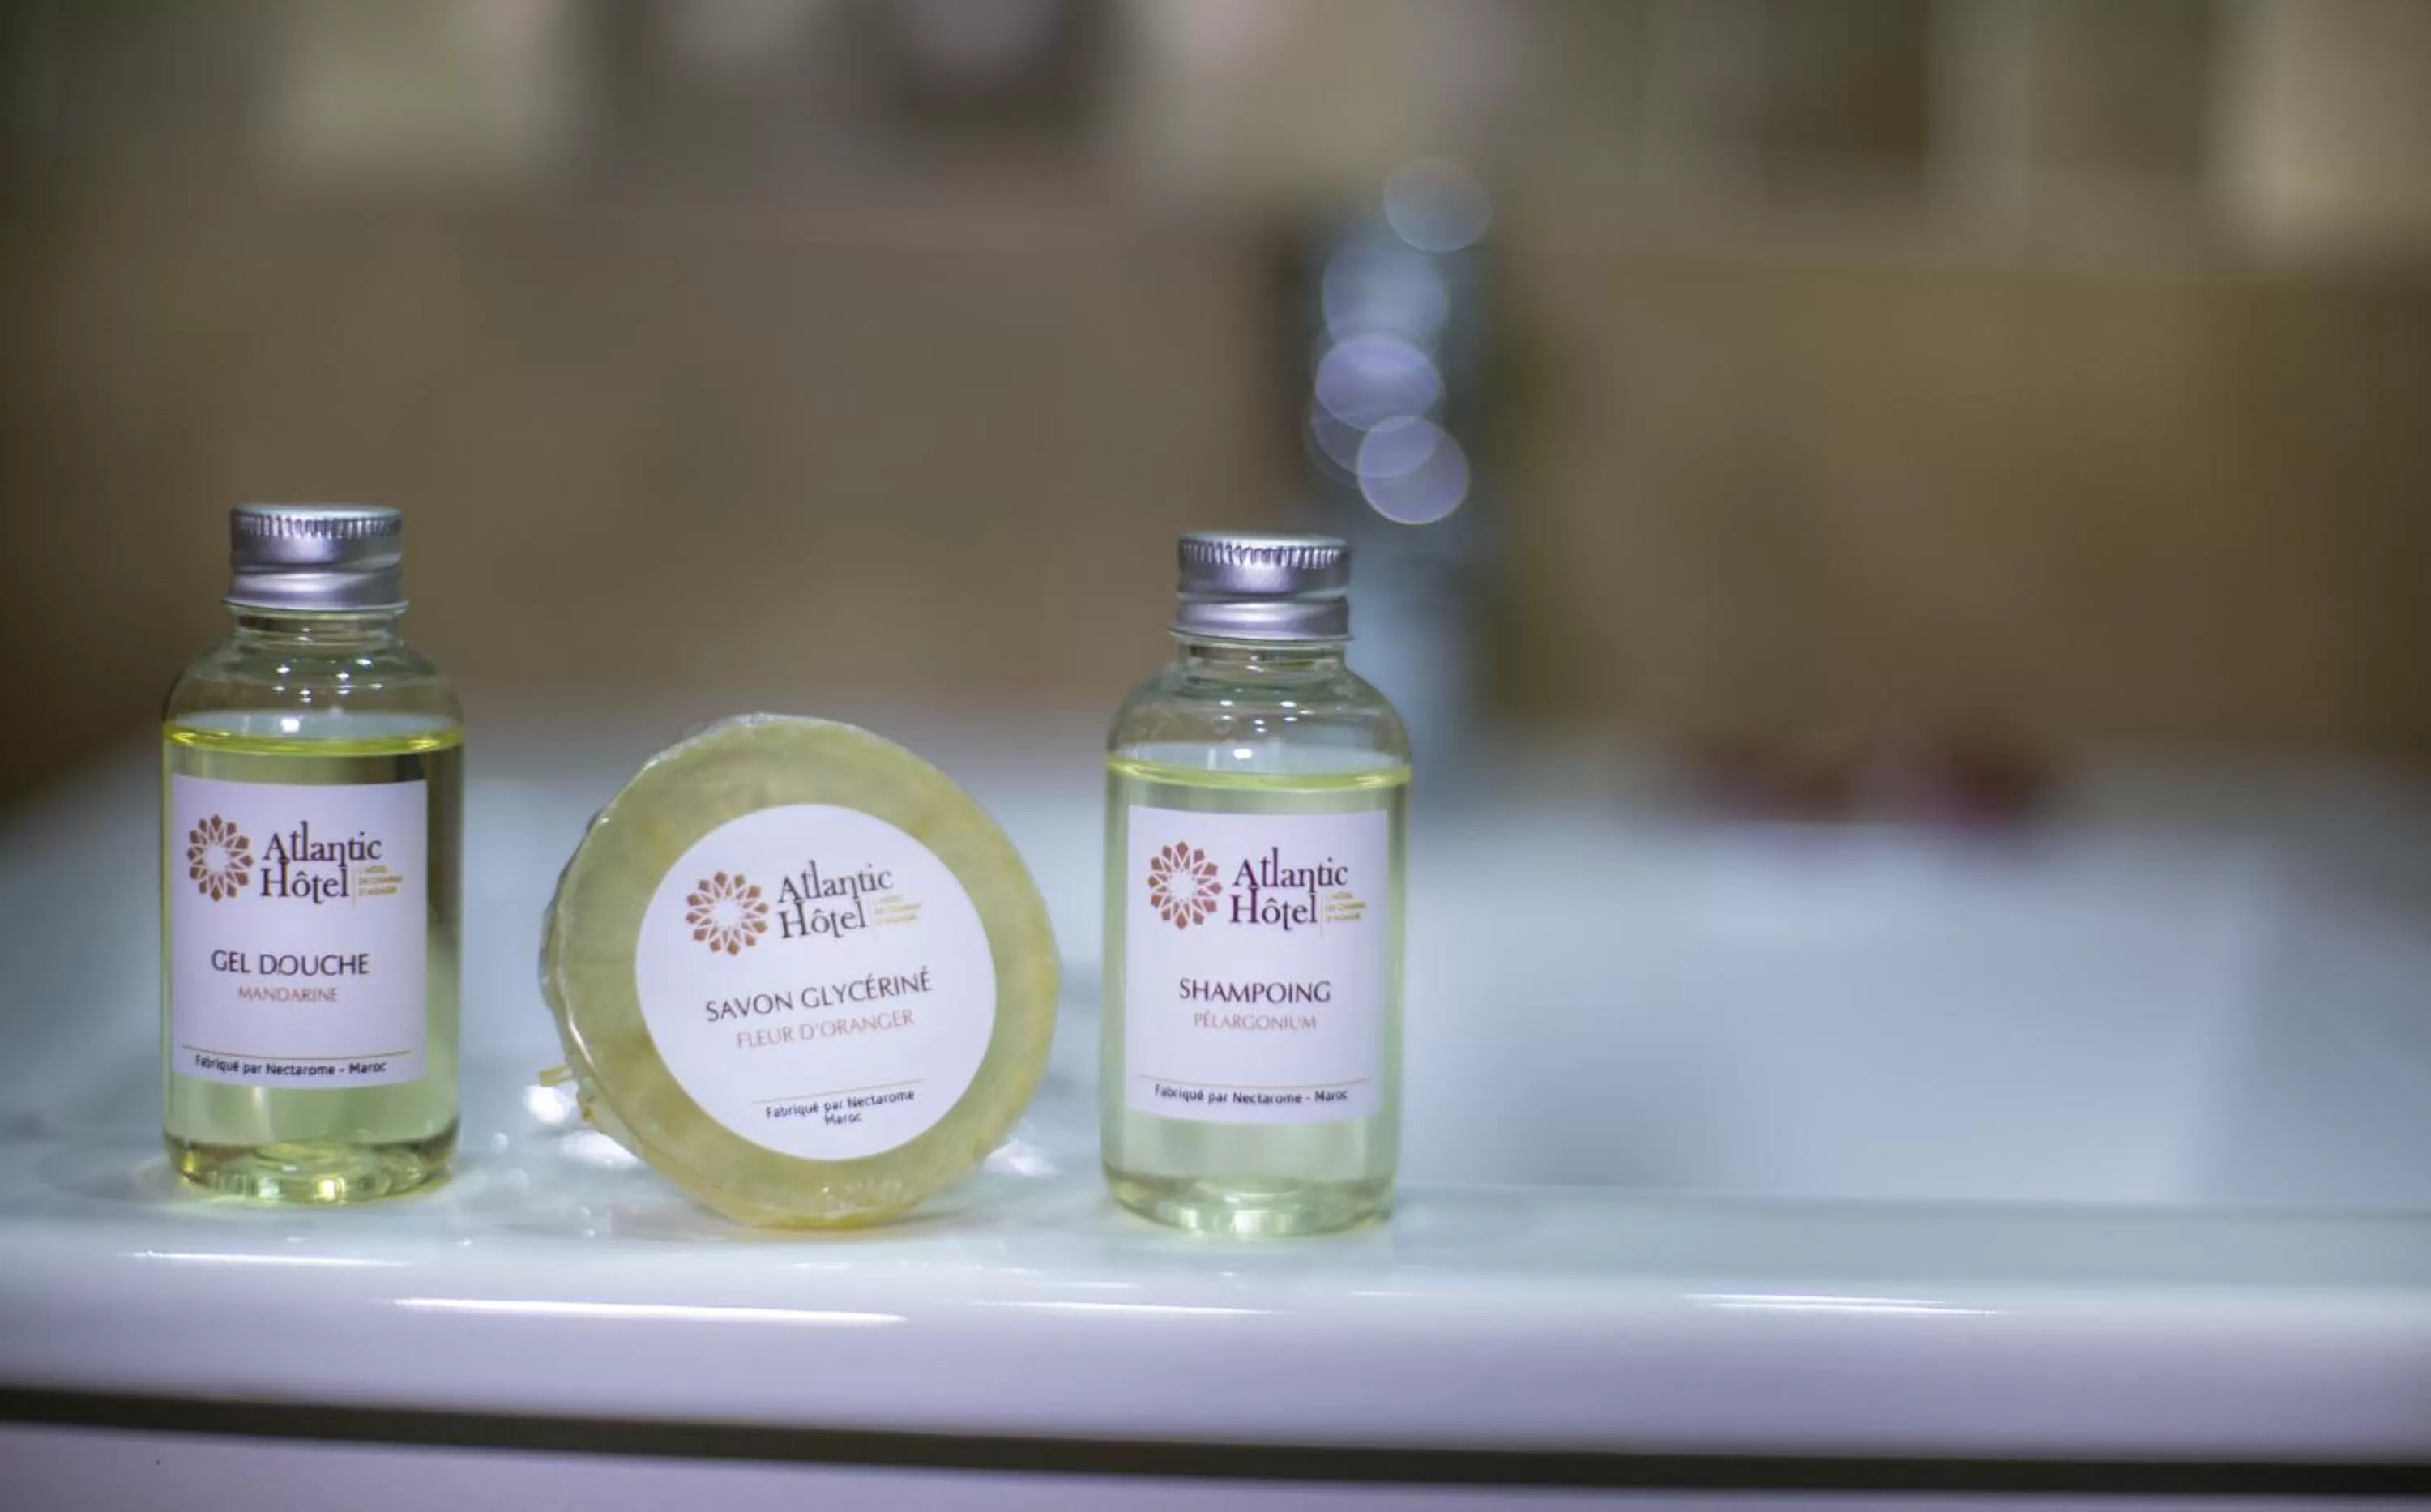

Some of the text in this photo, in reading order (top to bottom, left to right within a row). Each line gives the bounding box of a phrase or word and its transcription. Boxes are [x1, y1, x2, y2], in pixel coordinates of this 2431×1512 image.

[262, 819, 382, 867] Atlantic
[260, 858, 350, 905] Hôtel
[778, 859, 892, 903] Atlantic
[1232, 846, 1348, 892] Atlantic
[778, 897, 867, 938] Hôtel
[1229, 882, 1318, 931] Hôtel
[211, 950, 370, 976] GEL DOUCHE
[237, 985, 338, 1002] MANDARINE
[705, 965, 934, 1022] SAVON GLYCÉRINÉ
[1179, 977, 1331, 1004] SHAMPOING
[736, 1009, 916, 1049] FLEUR D'ORANGER
[1194, 1010, 1317, 1031] PÉLARGONIUM
[194, 1054, 240, 1074] Fabriqué
[244, 1062, 262, 1077] par
[266, 1063, 335, 1076] Nectarome
[348, 1061, 387, 1074] Maroc
[766, 1090, 915, 1120] Fabriqué par Nectarome
[1154, 1083, 1204, 1102] Fabriqué
[1208, 1091, 1228, 1104] par
[1233, 1091, 1302, 1104] Nectarome
[1314, 1090, 1348, 1102] Maroc
[824, 1112, 862, 1125] Maroc
